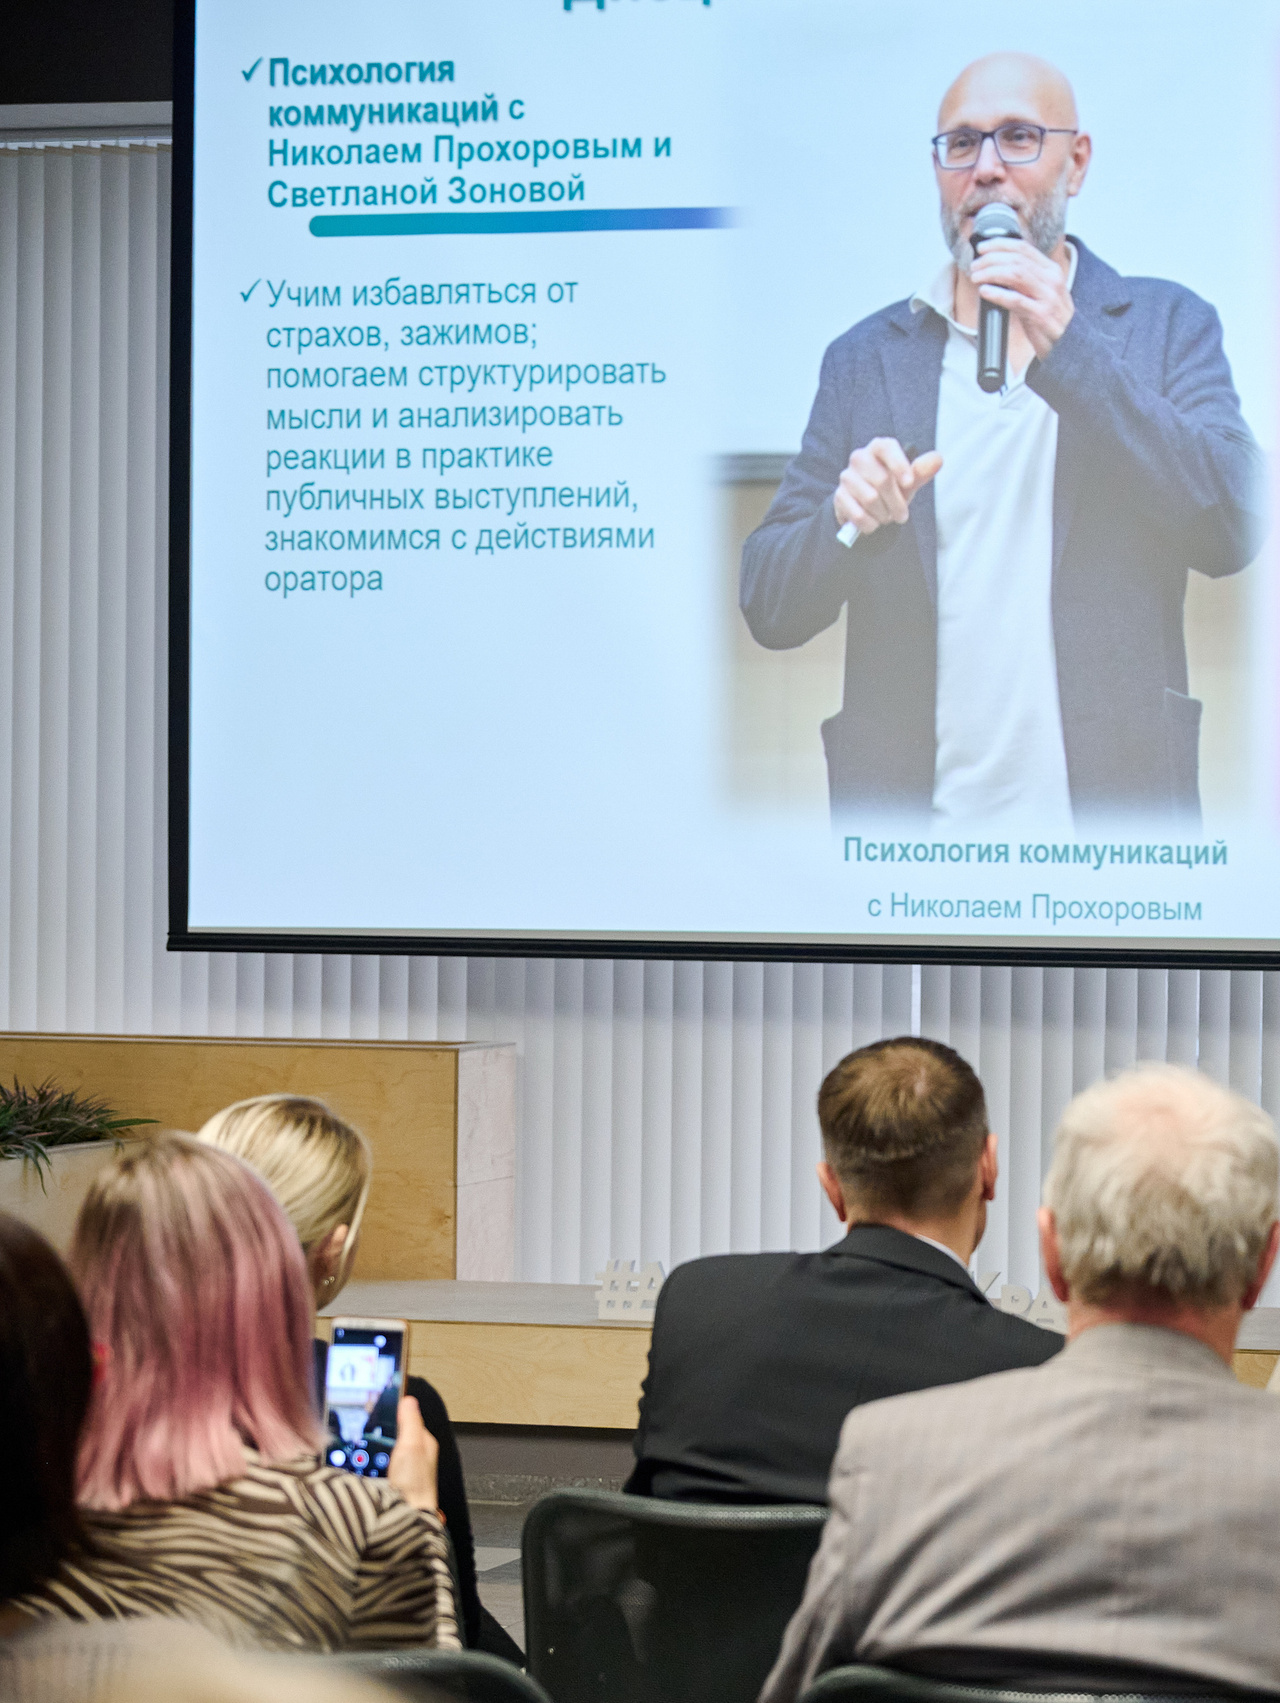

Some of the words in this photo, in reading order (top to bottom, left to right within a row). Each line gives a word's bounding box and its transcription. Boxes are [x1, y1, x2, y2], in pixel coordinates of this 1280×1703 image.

[270, 58, 454, 86] Психология
[270, 94, 497, 132] коммуникаций
[509, 100, 524, 119] с
[270, 139, 421, 166] Николаем
[435, 135, 641, 169] Прохоровым
[655, 138, 670, 157] и
[268, 178, 437, 207] Светланой
[449, 175, 584, 203] Зоновой
[267, 280, 340, 307] Учим
[354, 277, 535, 305] избавляться
[548, 282, 578, 303] от
[267, 326, 388, 354] страхов,
[401, 324, 535, 348] зажимов;
[268, 367, 406, 388] помогаем
[419, 363, 666, 392] структурировать
[268, 409, 360, 429] мысли
[373, 408, 387, 428] и
[399, 406, 622, 433] анализировать
[268, 449, 384, 477] реакции
[397, 449, 411, 468] в
[423, 443, 552, 475] практике
[267, 482, 424, 517] публичных
[436, 481, 636, 515] выступлений,
[266, 530, 439, 551] знакомимся
[452, 530, 466, 549] с
[476, 523, 653, 555] действиями
[265, 571, 382, 598] оратора
[845, 837, 1009, 863] Психология
[1020, 840, 1227, 870] коммуникаций
[868, 899, 881, 916] с
[891, 892, 1021, 918] Николаем
[1033, 894, 1201, 925] Прохоровым
